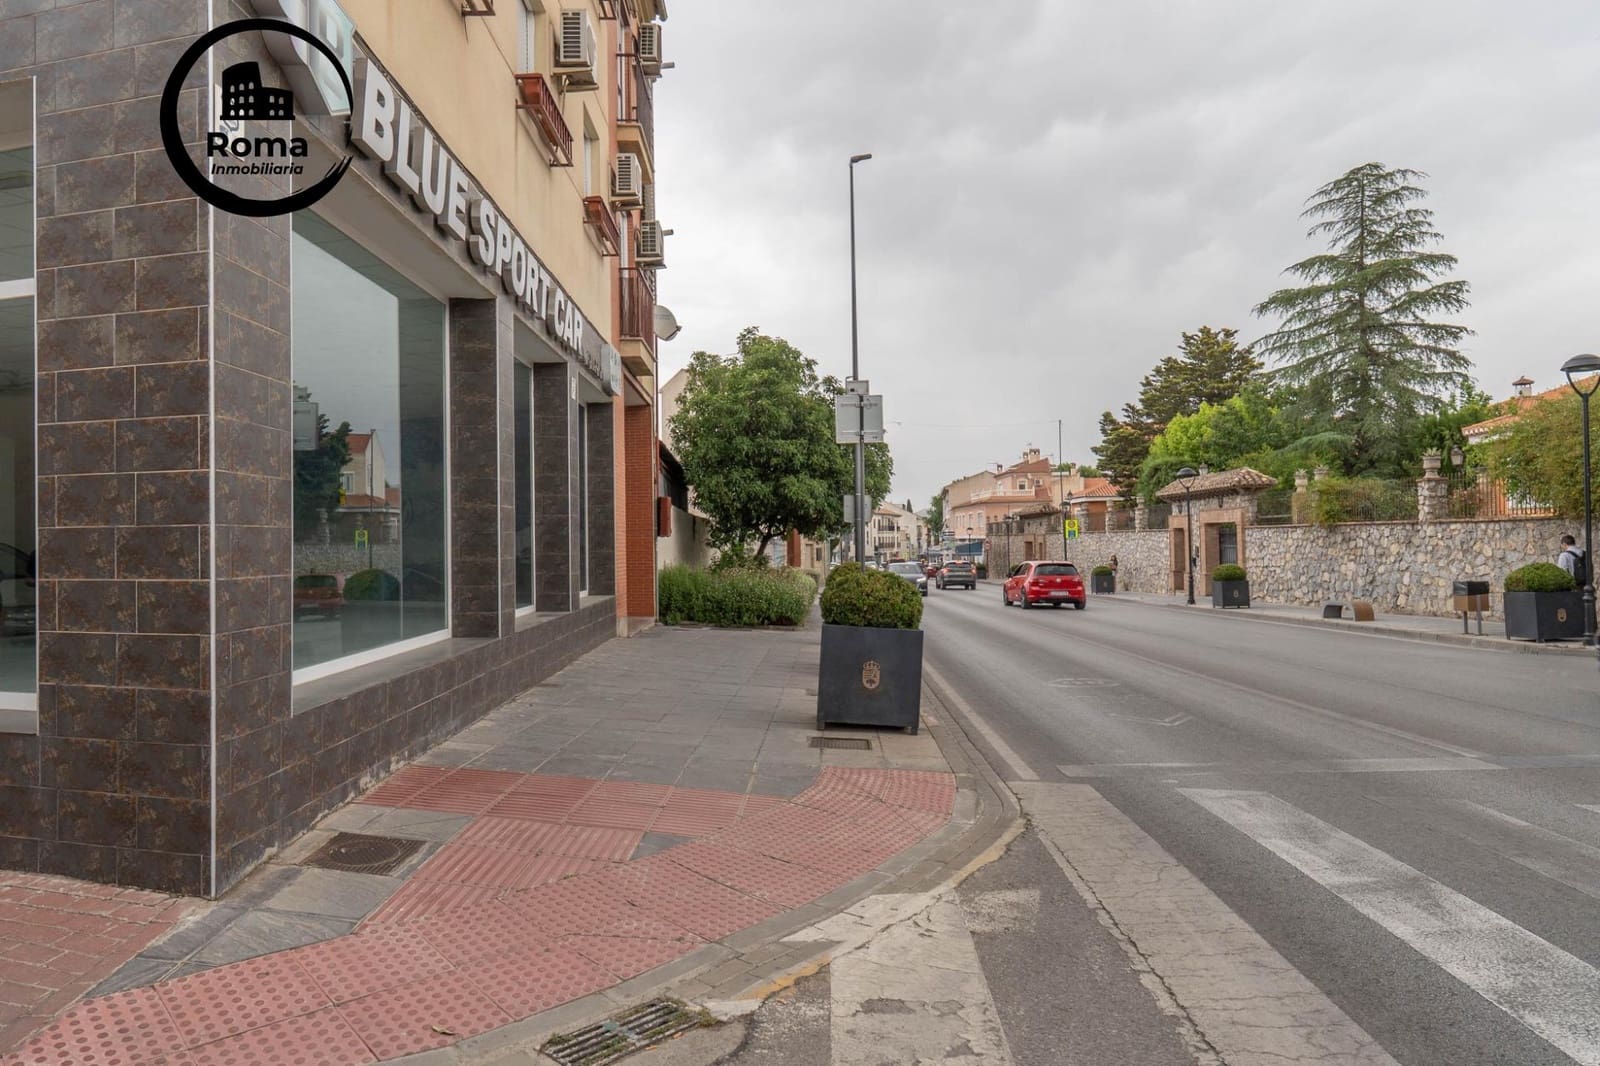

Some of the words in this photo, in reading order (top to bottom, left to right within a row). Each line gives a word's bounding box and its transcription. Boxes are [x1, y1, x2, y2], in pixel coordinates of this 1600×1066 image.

[361, 58, 469, 241] BLUE
[478, 199, 550, 321] SPORT
[554, 287, 583, 355] CAR
